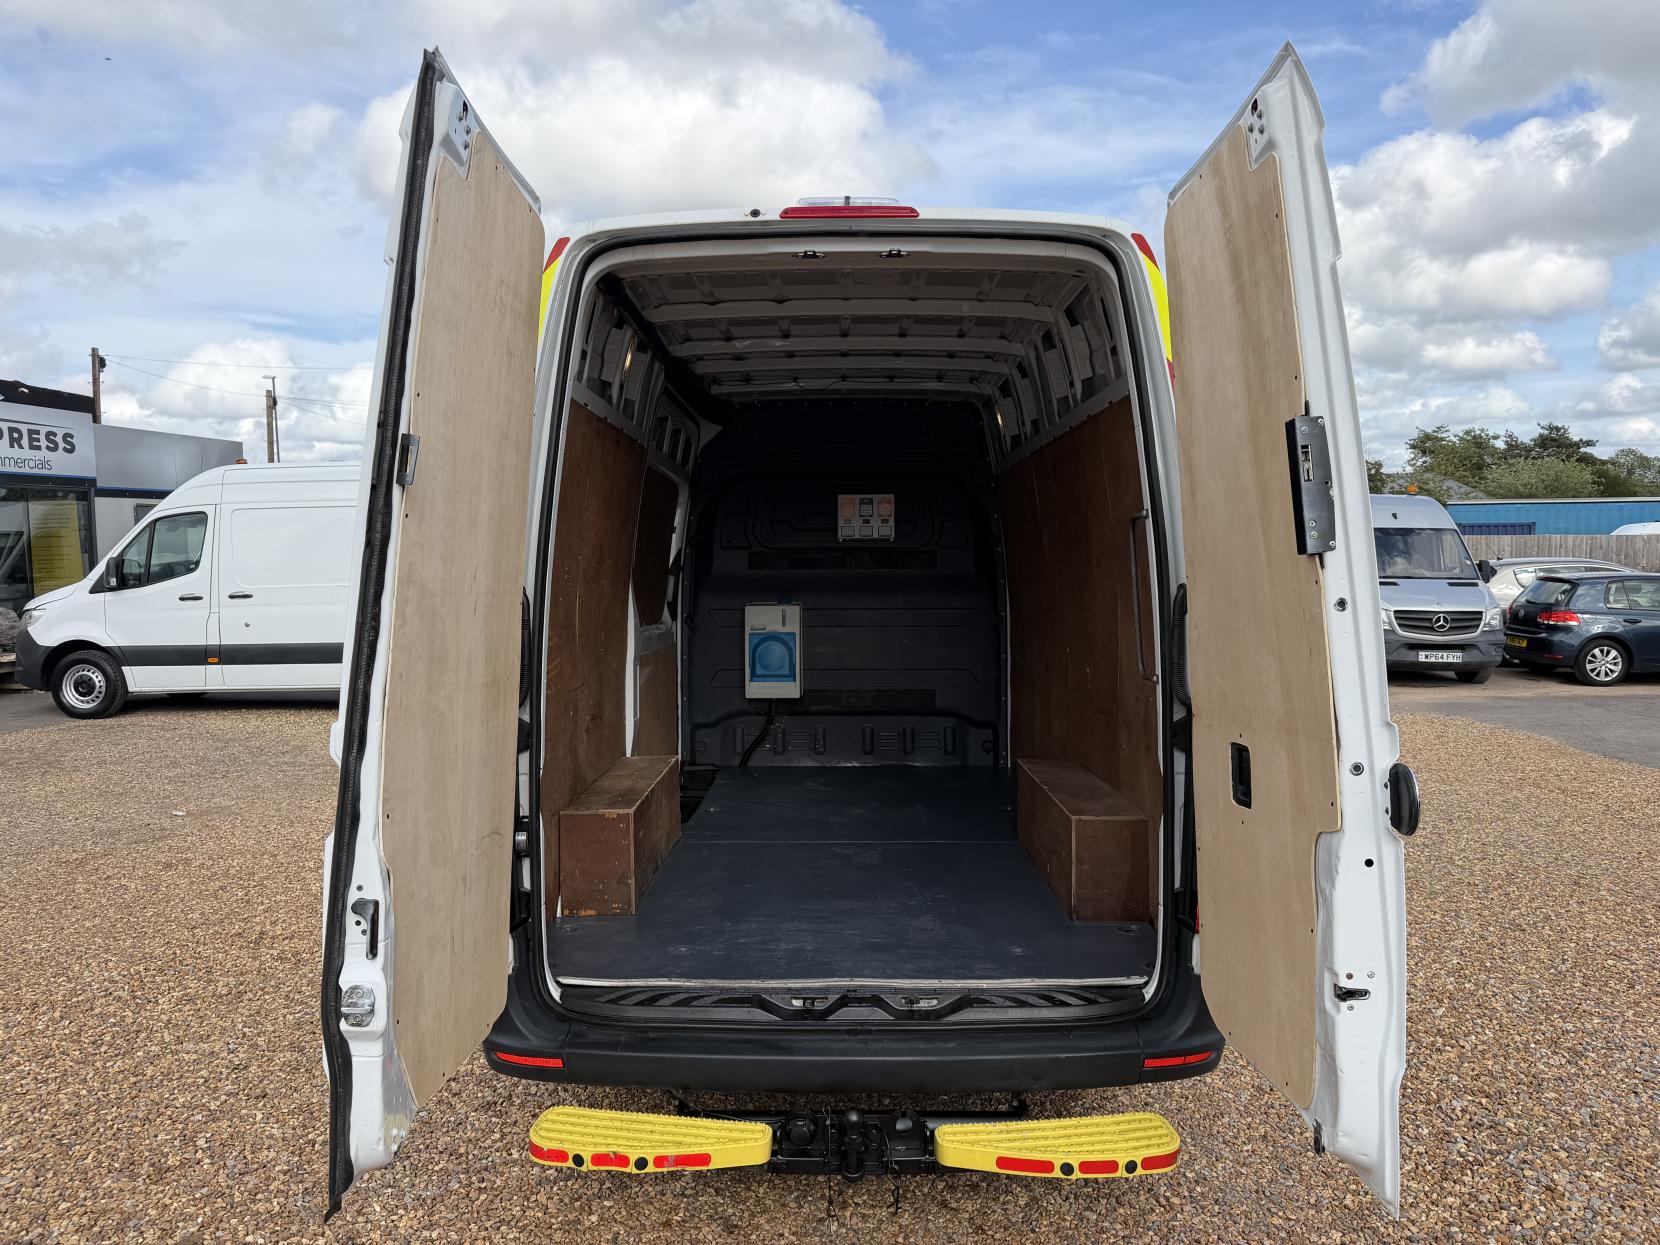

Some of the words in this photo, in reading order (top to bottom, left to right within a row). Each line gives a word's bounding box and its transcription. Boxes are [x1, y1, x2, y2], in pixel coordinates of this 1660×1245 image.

[0, 426, 76, 454] RESS
[0, 455, 53, 471] mercials
[1424, 653, 1444, 661] WP64
[1446, 653, 1461, 662] FYH
